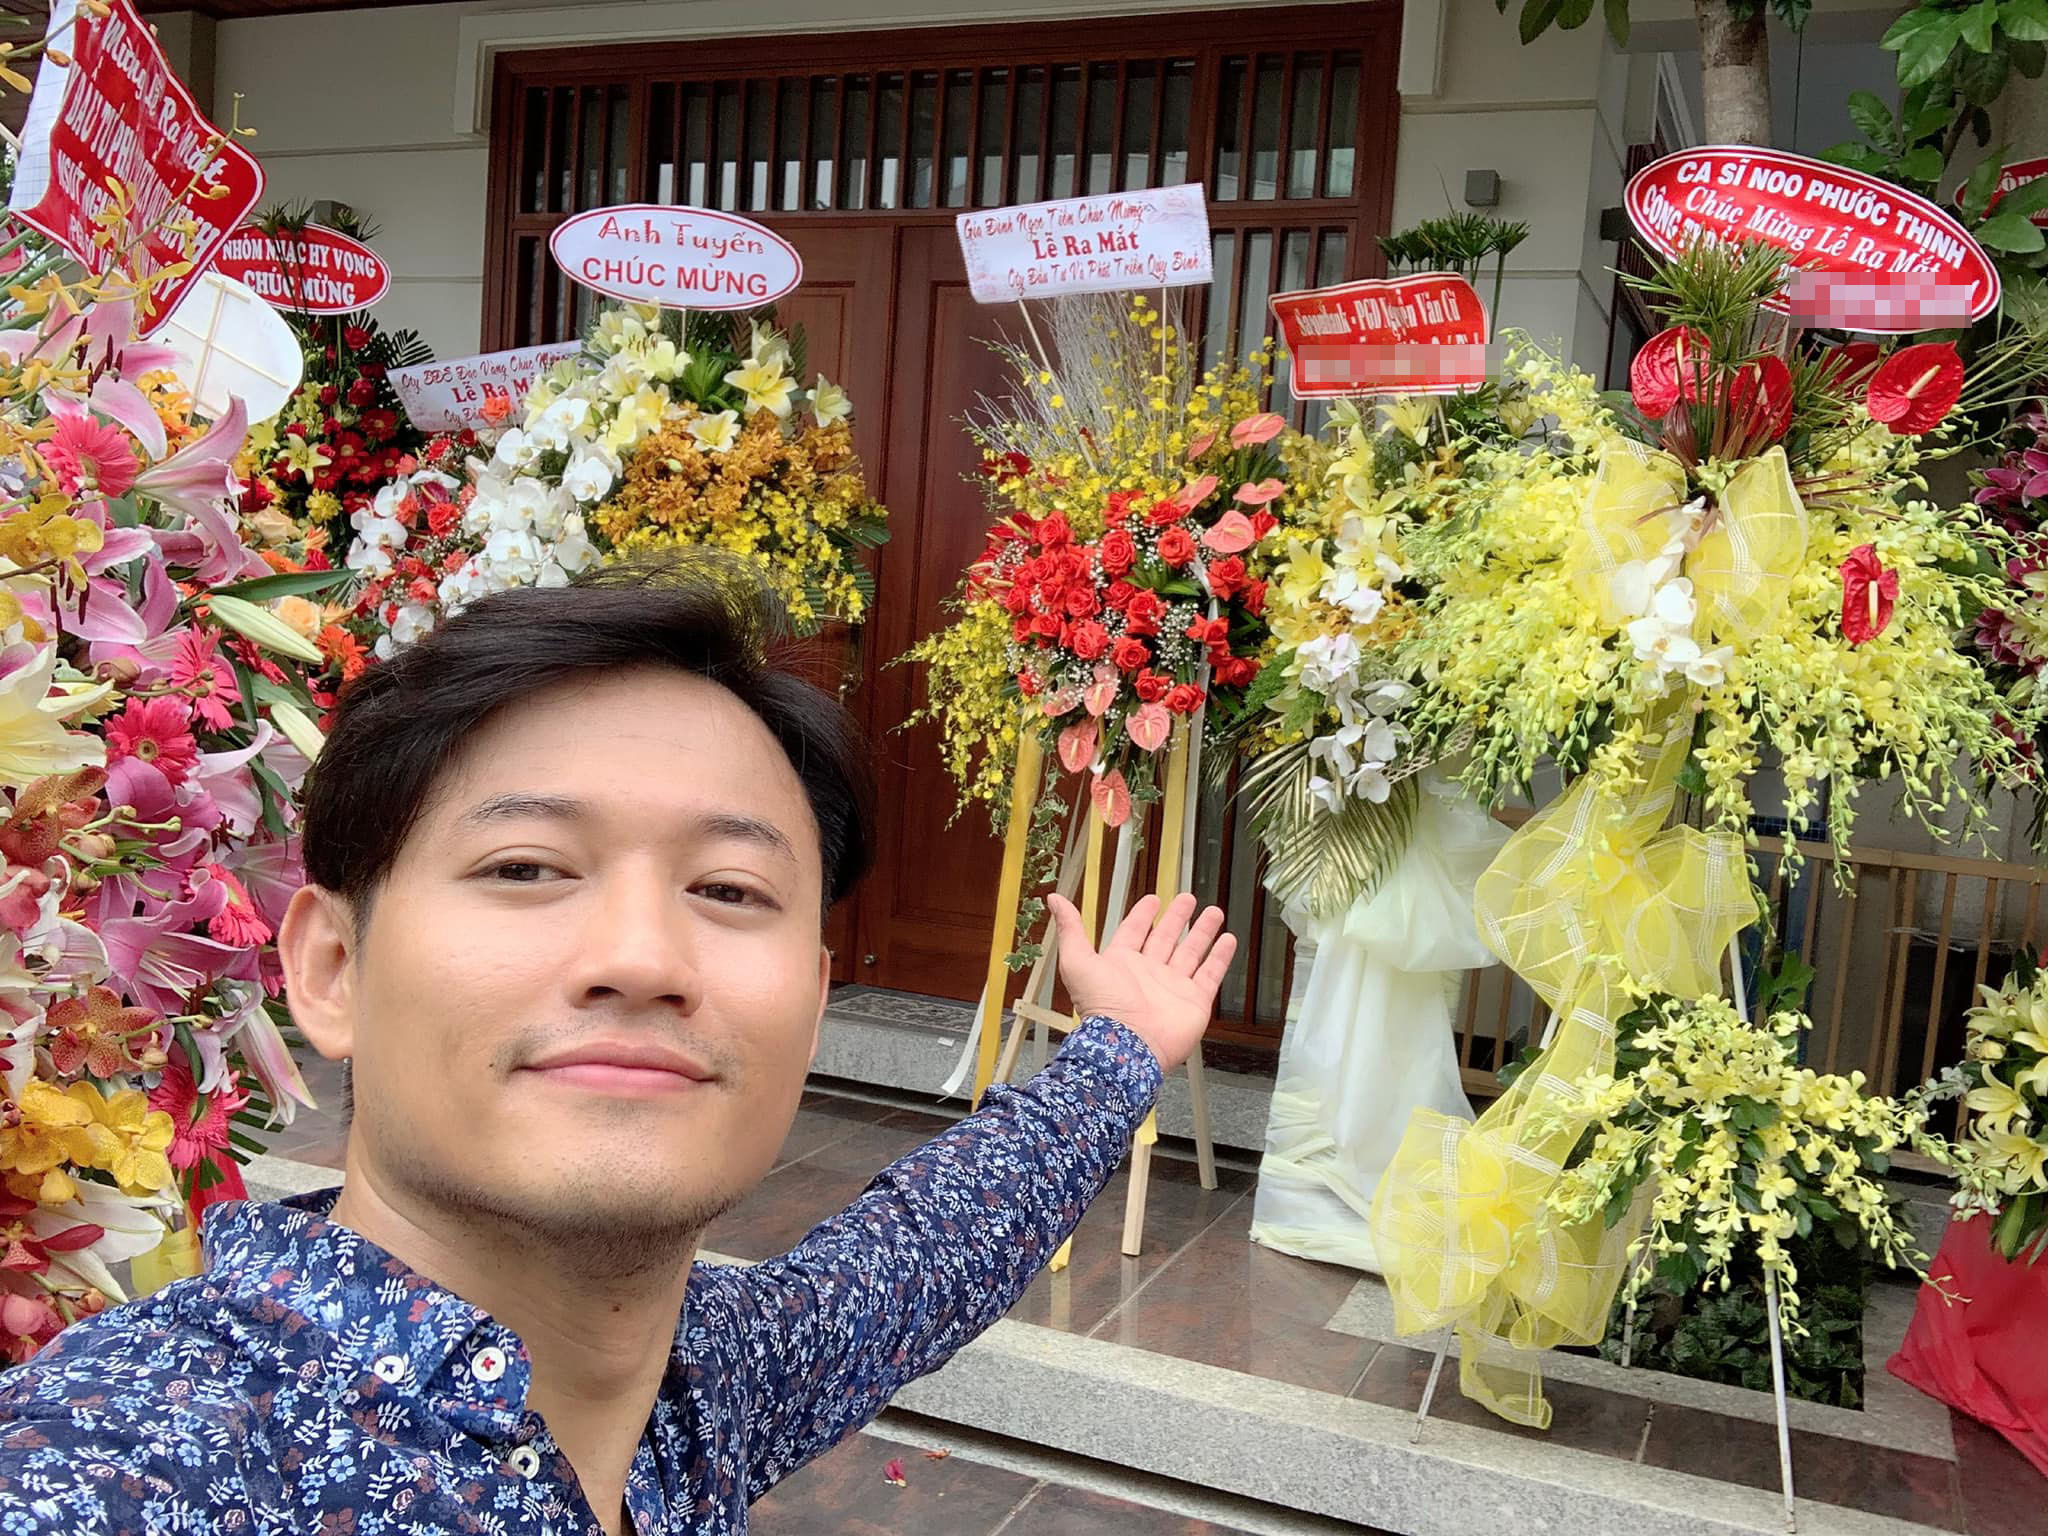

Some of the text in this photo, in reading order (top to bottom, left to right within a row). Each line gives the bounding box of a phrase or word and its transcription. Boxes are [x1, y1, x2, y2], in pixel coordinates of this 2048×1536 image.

[1642, 184, 1683, 241] CÔNG
[1677, 157, 1967, 270] CA SĨ NOO PHƯỚC THỊNH
[1685, 186, 1744, 225] Chúc
[1745, 204, 1815, 251] Mừng
[1813, 225, 1855, 257] Lễ
[1848, 236, 1888, 270] Ra
[222, 232, 376, 279] NHÓM NHẠC HY VỌNG
[598, 216, 764, 259] Anh Tuyến
[1032, 224, 1139, 260] Lễ Ra Mắt
[243, 266, 356, 306] CHÚC MỪNG
[583, 256, 767, 297] CHÚC MỪNG
[452, 380, 477, 403] Lễ
[481, 382, 509, 398] Ra
